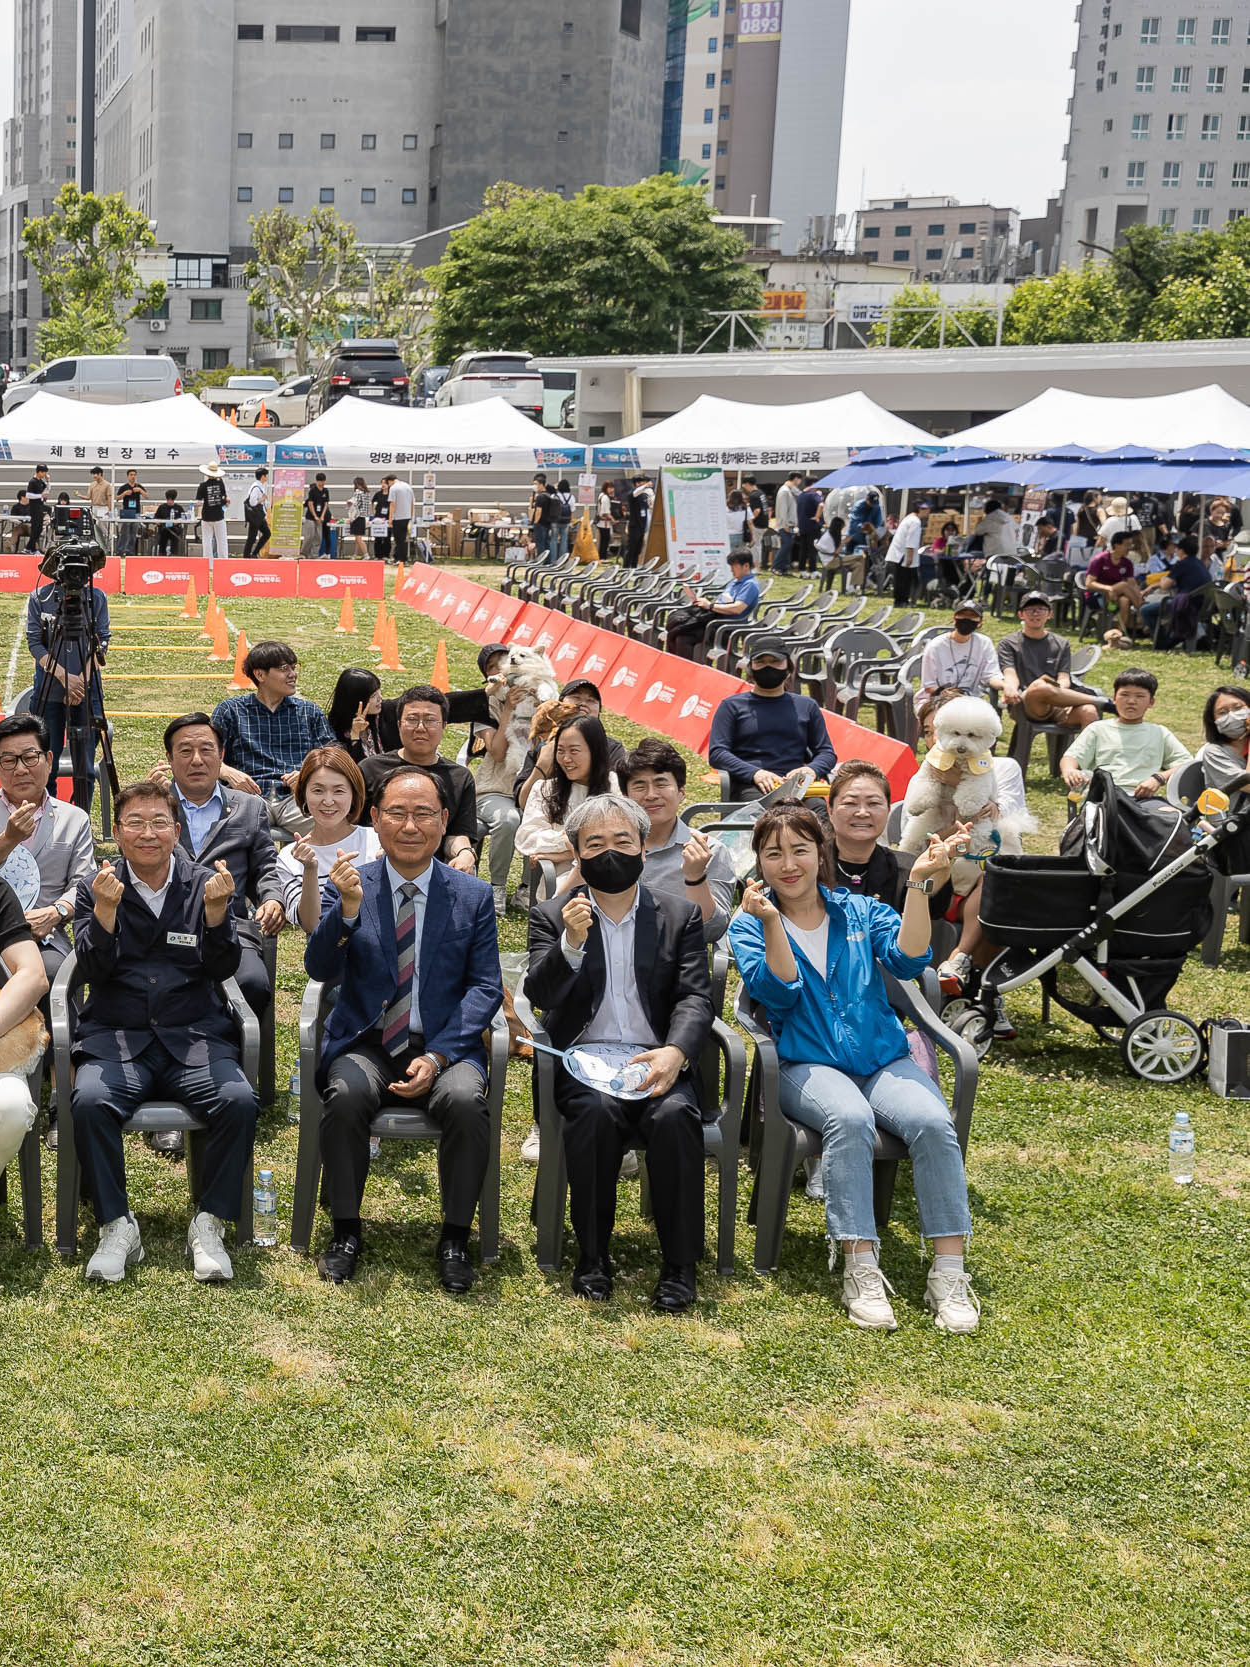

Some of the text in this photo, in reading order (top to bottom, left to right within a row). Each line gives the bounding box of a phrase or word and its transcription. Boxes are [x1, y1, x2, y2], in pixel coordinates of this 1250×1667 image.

[742, 1, 781, 18] 1811
[740, 17, 780, 34] 0893
[369, 452, 392, 465] 멍멍
[664, 451, 820, 465] 아임도그너와 함께하는 응급처치 교육
